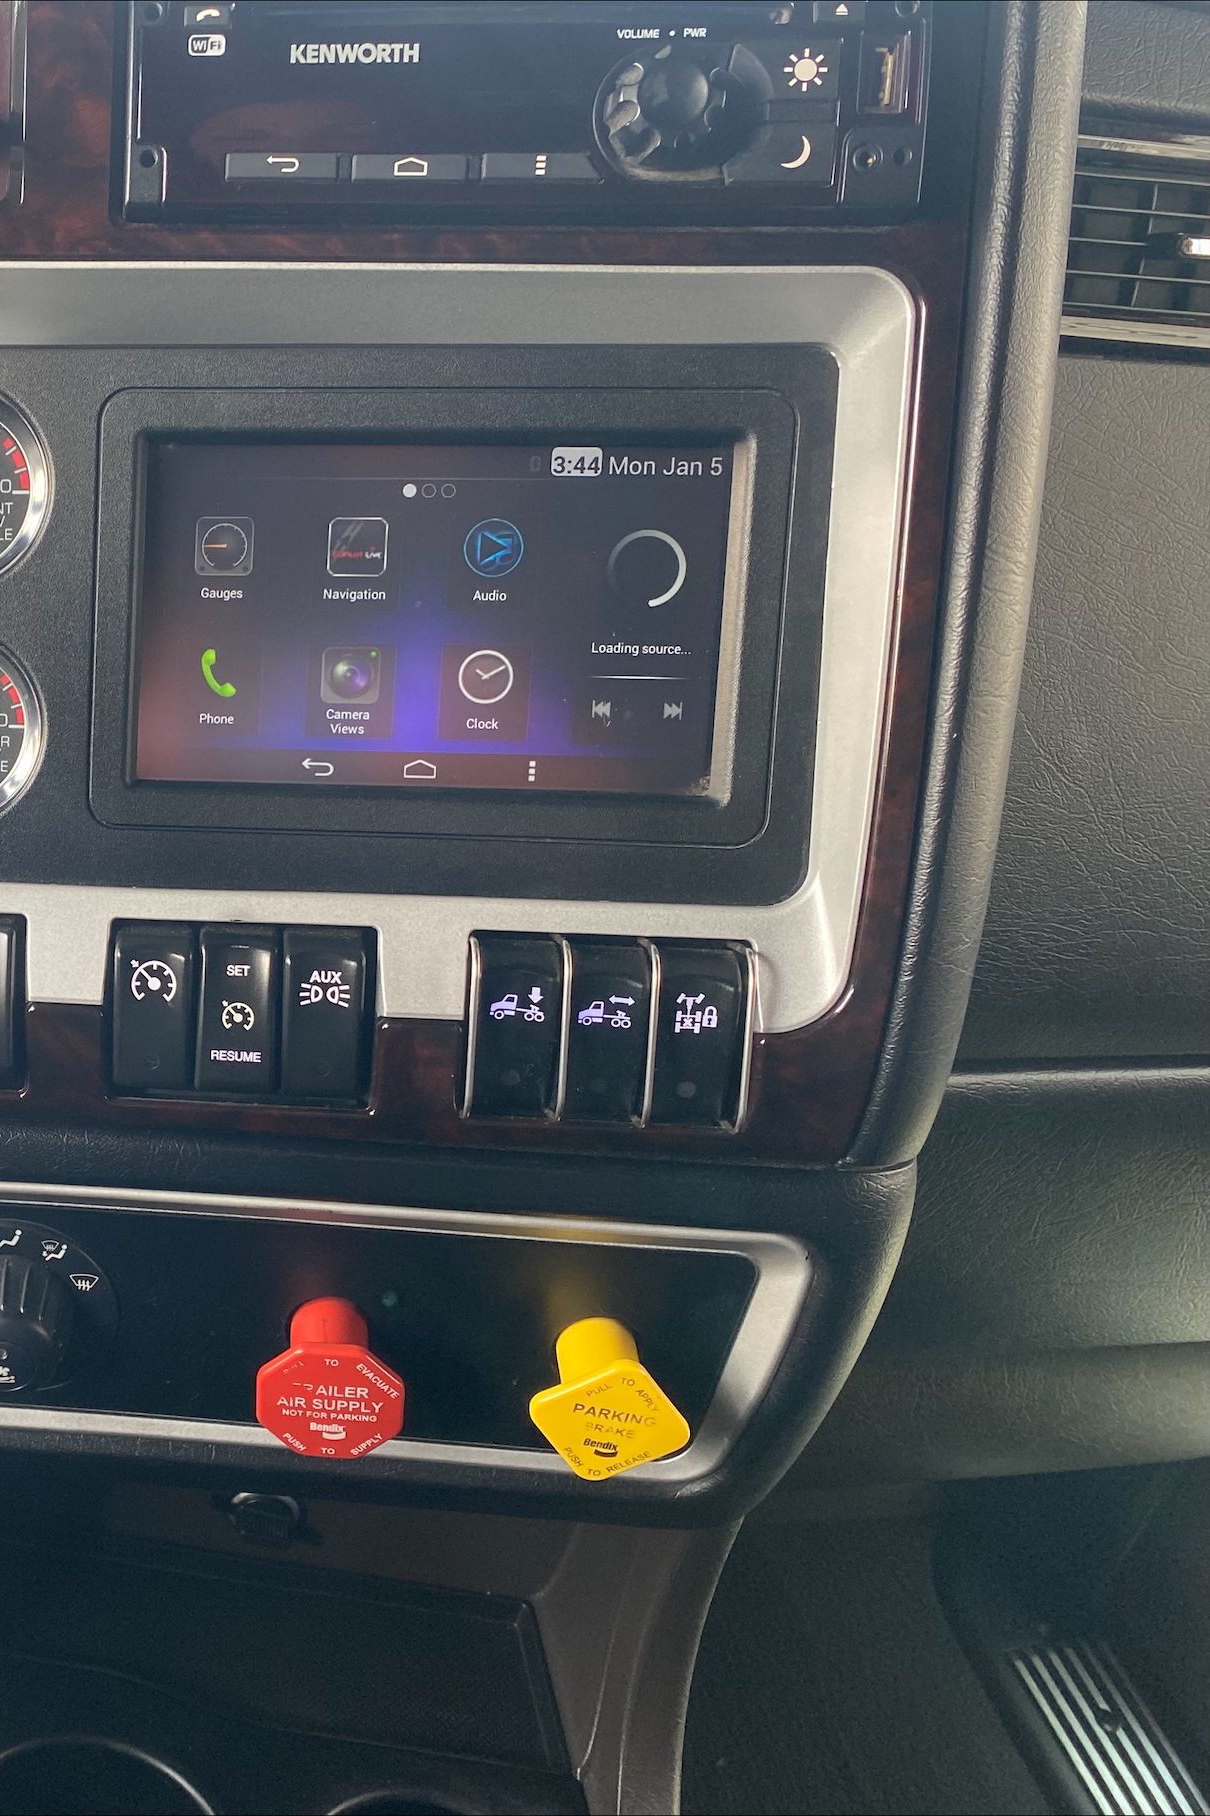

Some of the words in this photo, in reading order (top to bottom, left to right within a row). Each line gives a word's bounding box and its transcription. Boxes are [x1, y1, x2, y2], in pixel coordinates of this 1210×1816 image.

[617, 29, 660, 39] VOLUME
[683, 28, 707, 38] PWR
[290, 42, 420, 65] KENWORTH
[553, 456, 600, 474] 3:44
[608, 456, 656, 475] Mon
[663, 457, 703, 476] Jan
[710, 457, 723, 476] 5
[201, 588, 243, 601] Gauges
[323, 588, 386, 603] Navigation
[473, 590, 507, 602] Audio
[591, 641, 638, 658] Loading
[641, 645, 692, 657] source...
[199, 712, 234, 725] Phone
[326, 709, 370, 721] Camera
[330, 723, 365, 735] Views
[466, 718, 499, 730] Clock
[226, 965, 250, 977] SET
[310, 971, 342, 985] AUX
[210, 1050, 262, 1063] RESUME
[324, 1358, 339, 1367] TO
[355, 1363, 400, 1399] EVACUATE
[586, 1383, 613, 1397] PULL
[621, 1377, 636, 1387] TO
[635, 1389, 659, 1413] APPLY
[277, 1396, 307, 1408] AIR
[312, 1399, 384, 1413] SUPPLY
[282, 1408, 304, 1417] NOT
[306, 1411, 328, 1419] FOR
[330, 1413, 378, 1422] PARKING
[573, 1403, 657, 1427] PARKING
[309, 1422, 345, 1433] Bendix
[585, 1422, 636, 1439] BRAKE
[282, 1432, 307, 1451] PUSH
[321, 1447, 336, 1455] TO
[350, 1433, 383, 1456] SUPPLY
[583, 1438, 619, 1451] Bendix
[564, 1446, 584, 1468] PUSH
[587, 1468, 602, 1477] TO
[606, 1451, 652, 1474] RELEASE
